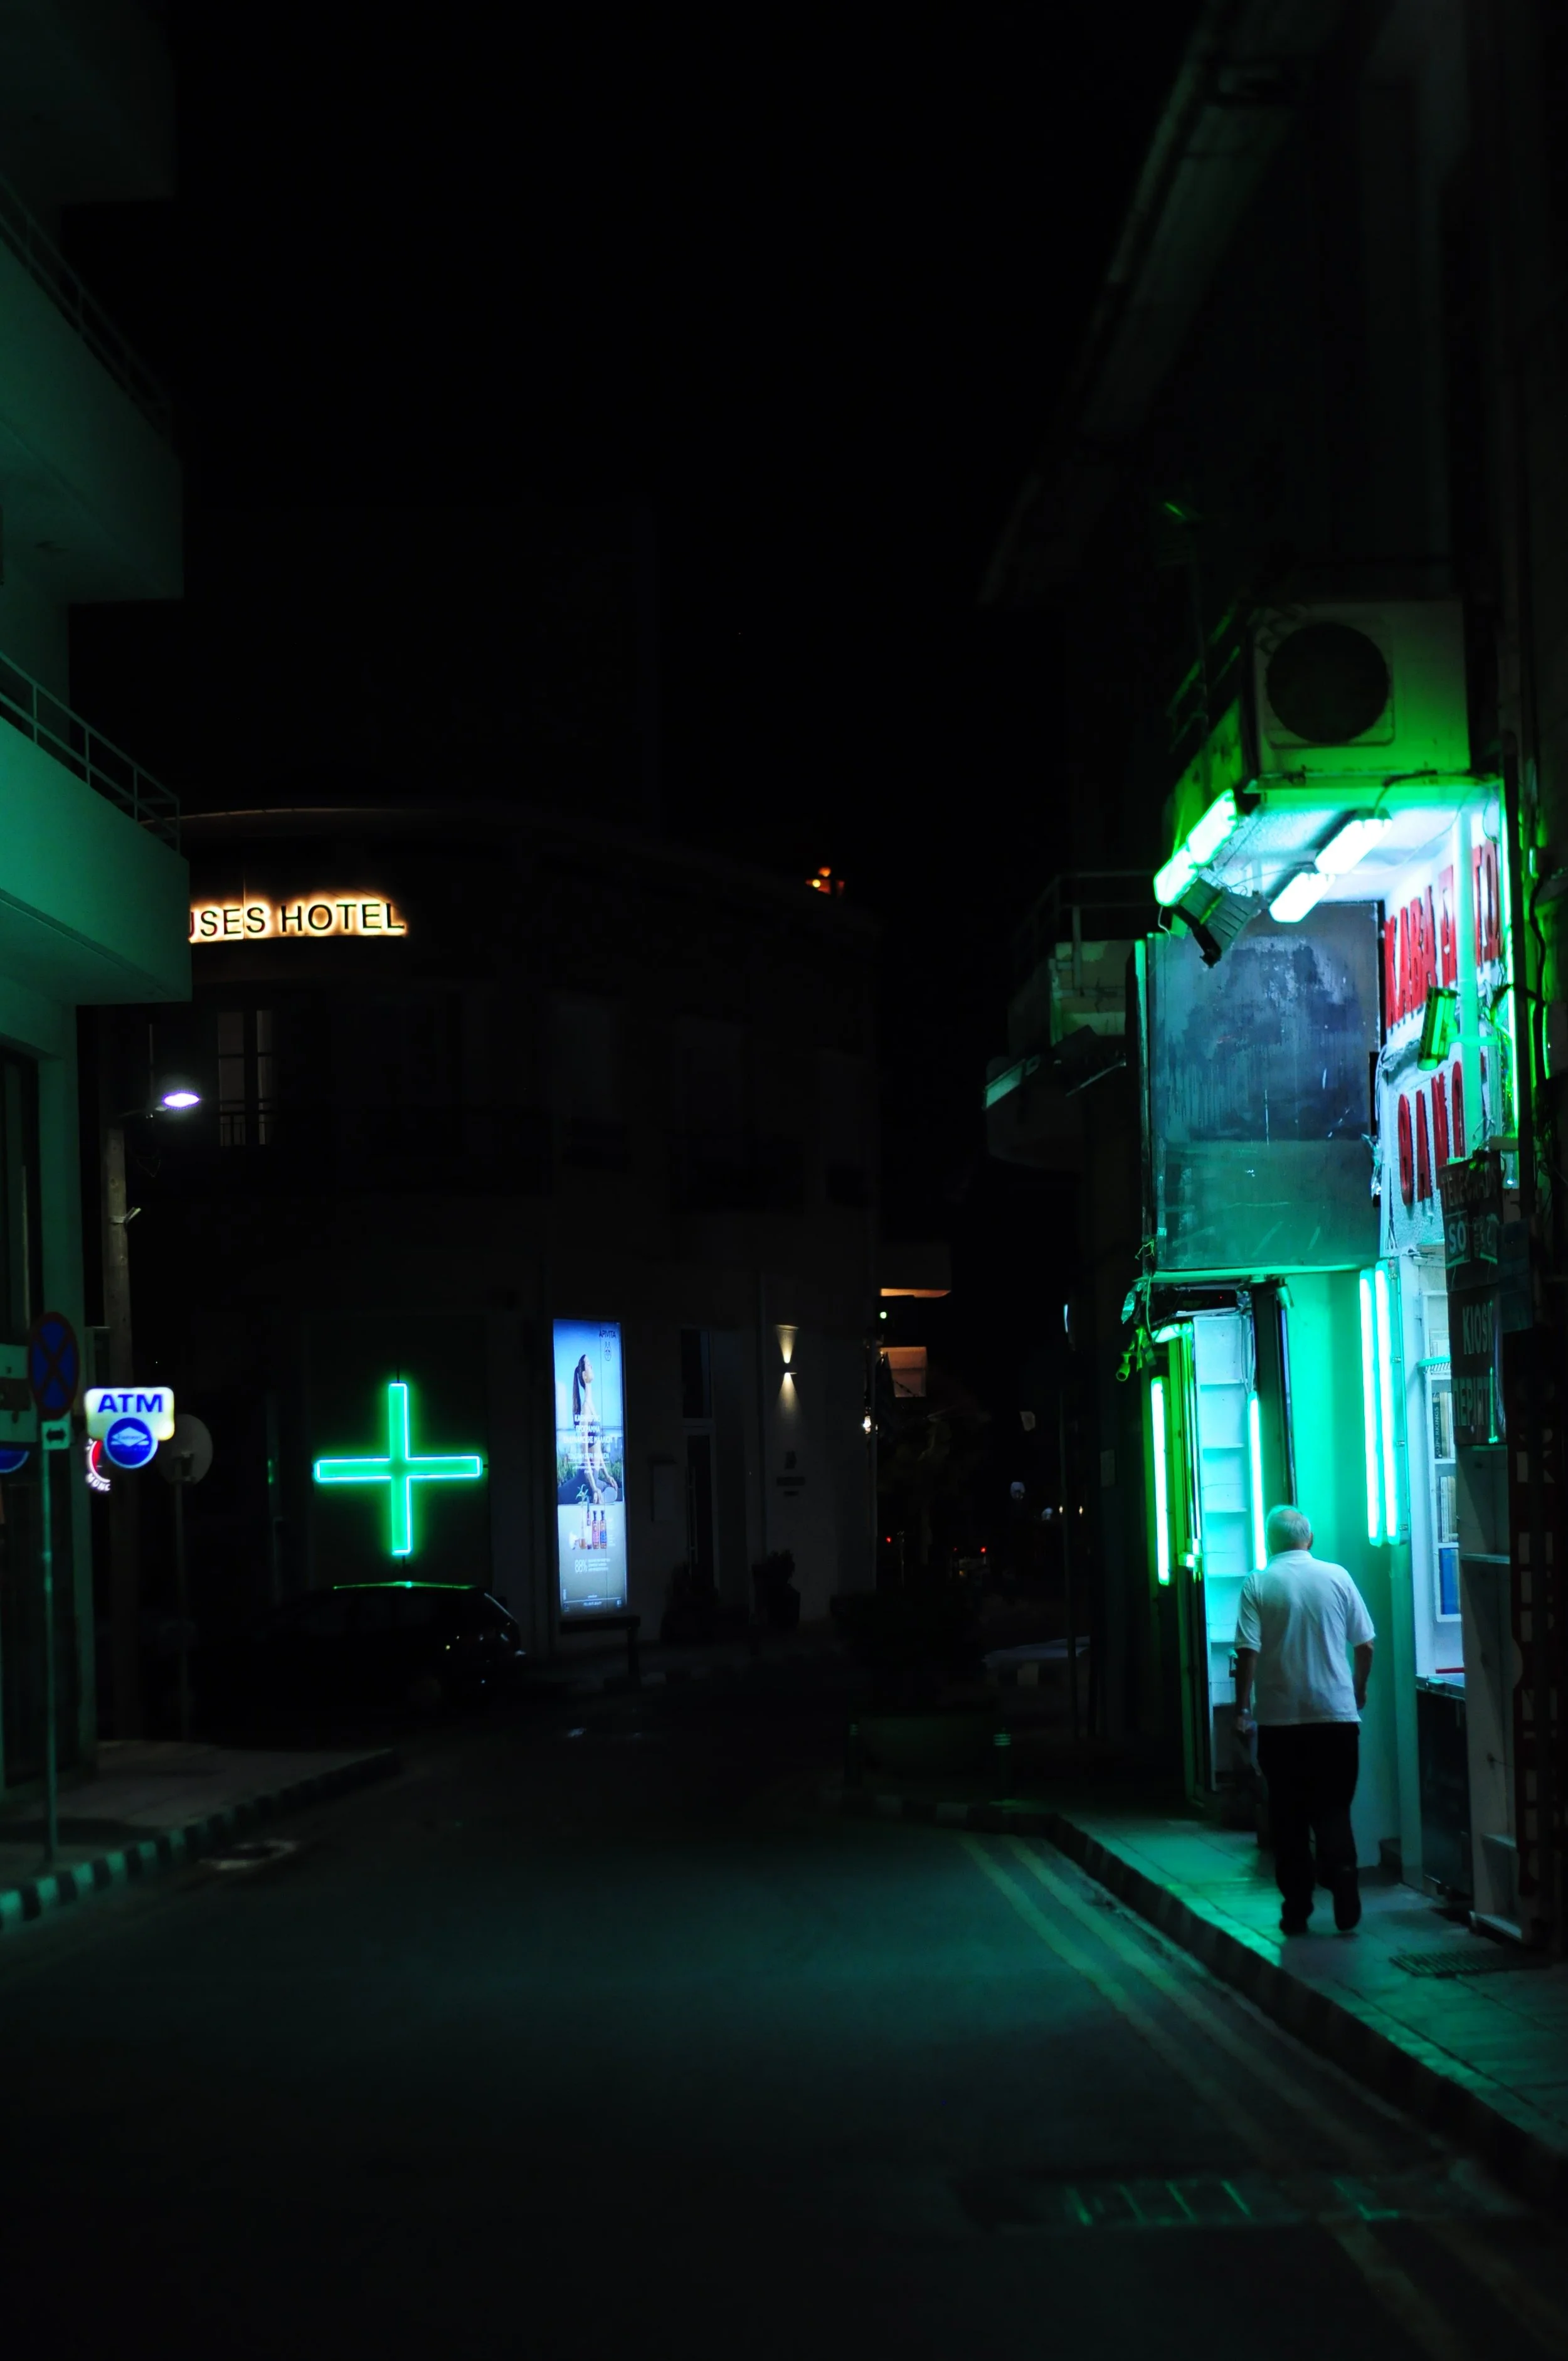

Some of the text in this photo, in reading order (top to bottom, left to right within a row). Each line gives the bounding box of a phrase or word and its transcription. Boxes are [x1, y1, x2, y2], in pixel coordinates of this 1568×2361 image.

[281, 903, 405, 933] HOTEL
[1462, 1302, 1493, 1355] KIOSK
[97, 1394, 163, 1413] ATM
